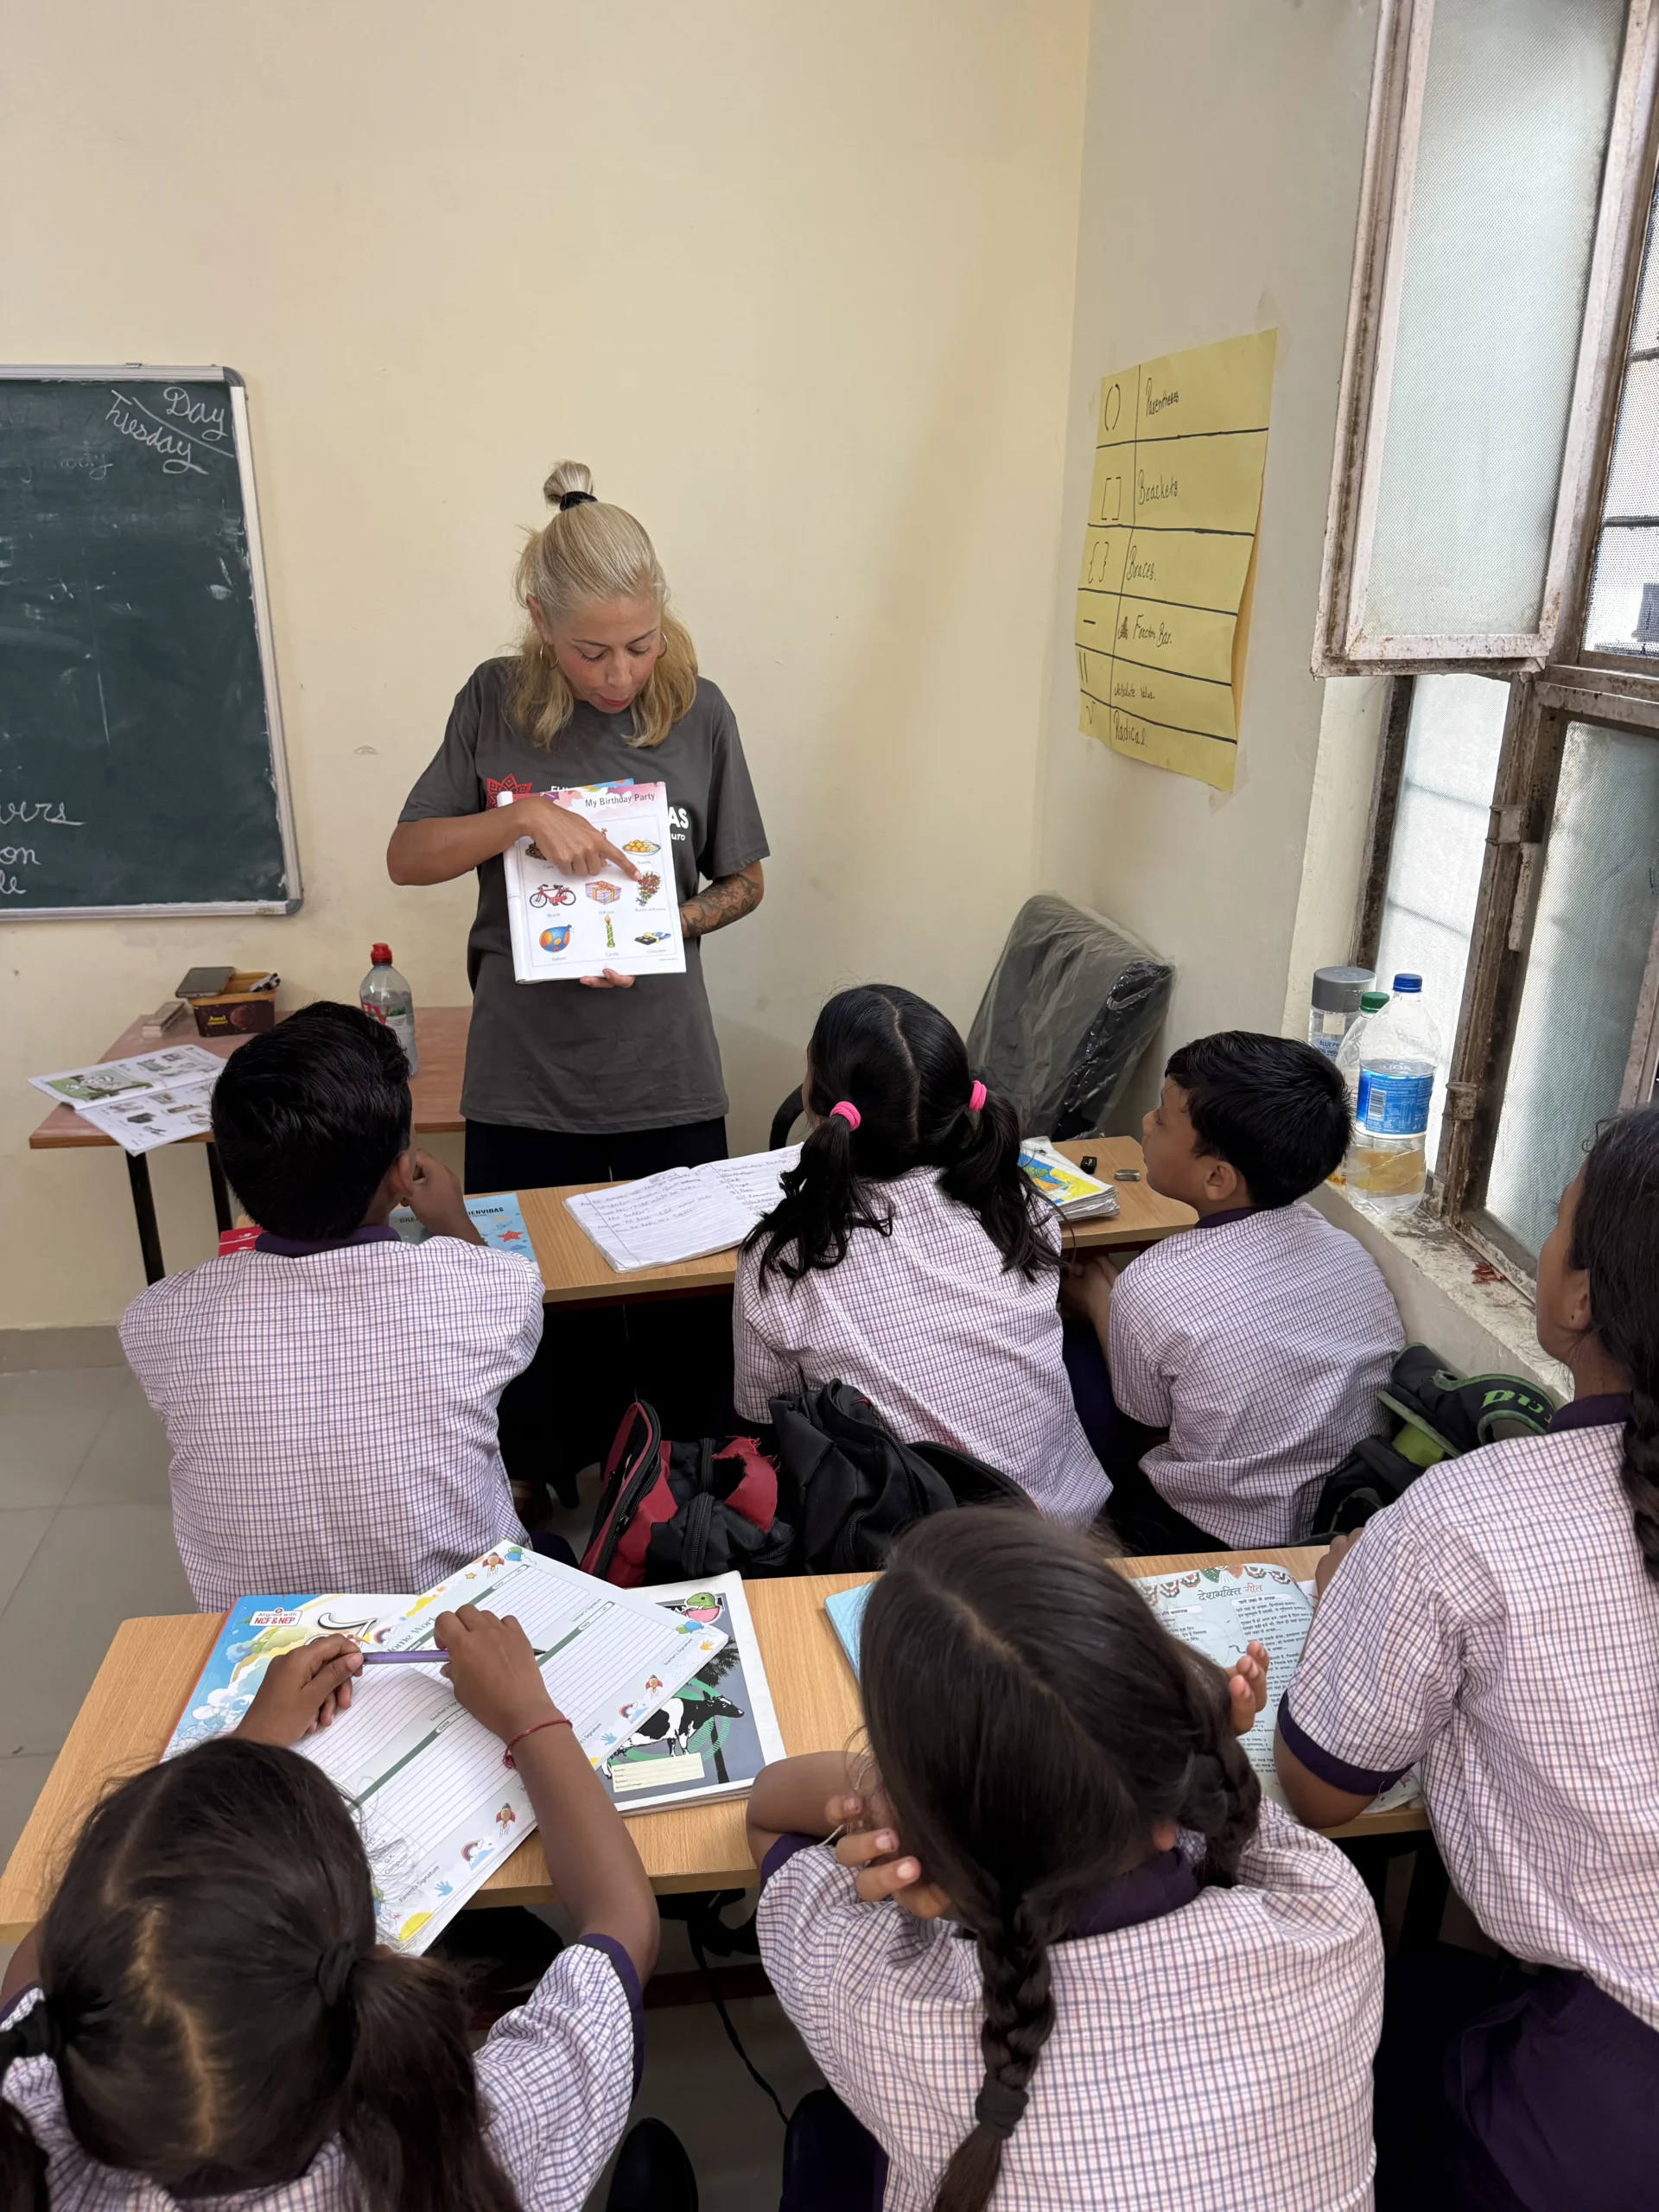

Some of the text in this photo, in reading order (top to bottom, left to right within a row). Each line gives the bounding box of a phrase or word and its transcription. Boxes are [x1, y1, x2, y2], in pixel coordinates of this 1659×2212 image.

[163, 386, 228, 441] Day
[105, 390, 209, 474] Tuesday
[585, 792, 656, 808] My Birthday Party
[438, 1720, 449, 1731] Date
[385, 1853, 408, 1875] Computer
[398, 1865, 441, 1903] Parent's Signature
